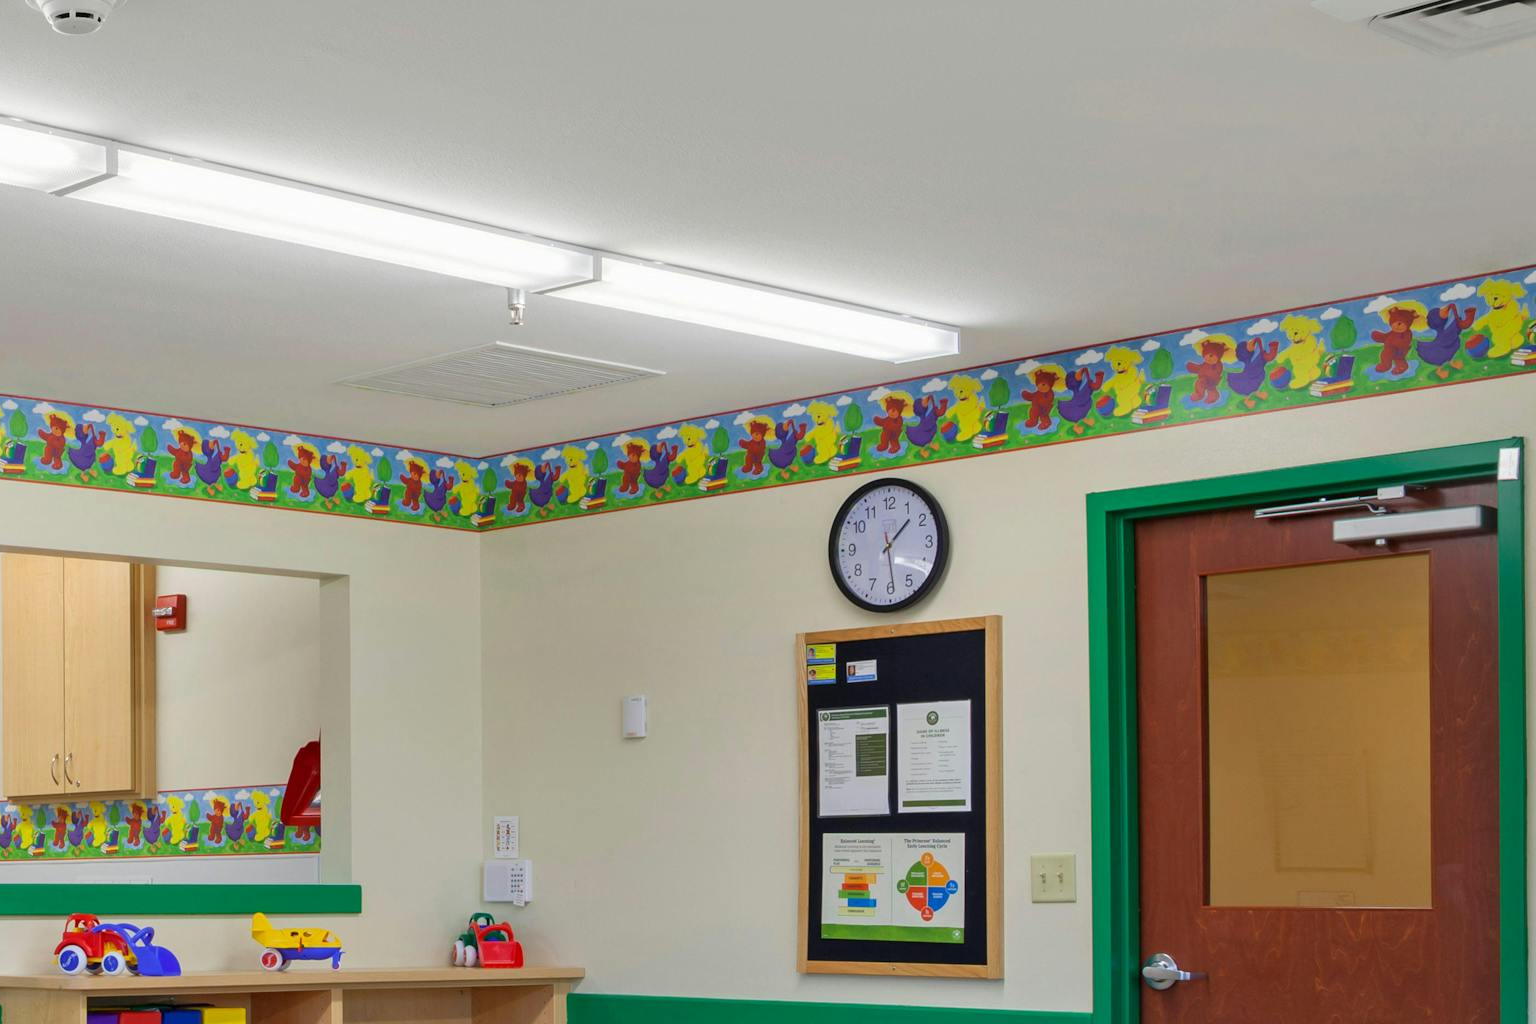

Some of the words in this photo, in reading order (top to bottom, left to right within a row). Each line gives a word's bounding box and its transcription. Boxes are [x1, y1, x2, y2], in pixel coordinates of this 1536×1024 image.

[882, 496, 896, 510] 12
[904, 501, 910, 515] 1
[864, 506, 877, 520] 11
[918, 513, 927, 527] 2
[852, 519, 866, 534] 10
[925, 534, 934, 549] 3
[848, 543, 857, 557] 9
[854, 563, 863, 577] 8
[868, 577, 877, 591] 7
[886, 581, 895, 595] 6
[905, 574, 914, 588] 5
